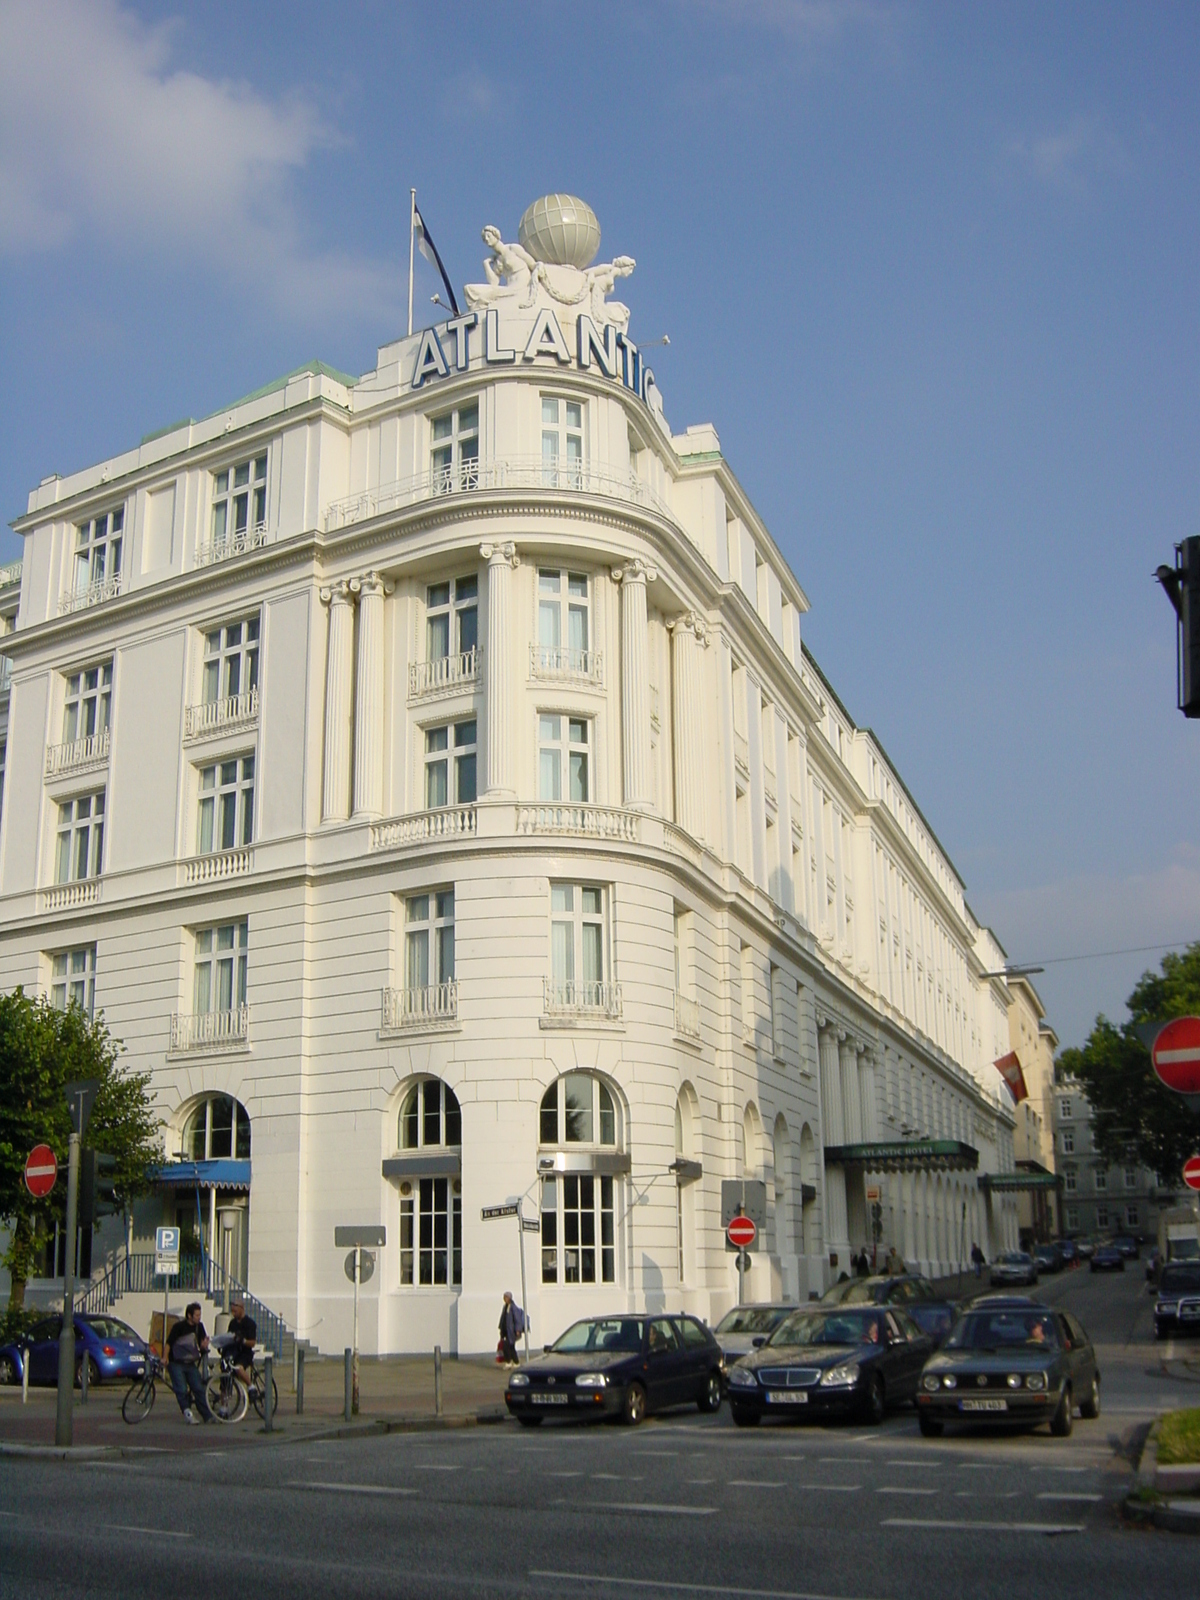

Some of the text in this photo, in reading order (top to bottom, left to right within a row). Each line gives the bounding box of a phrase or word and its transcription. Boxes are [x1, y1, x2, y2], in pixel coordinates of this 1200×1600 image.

[412, 308, 656, 412] ATLANTIC
[861, 1146, 934, 1157] ATLANTIC HOTEL
[501, 1207, 516, 1215] Alster
[162, 1230, 174, 1248] P
